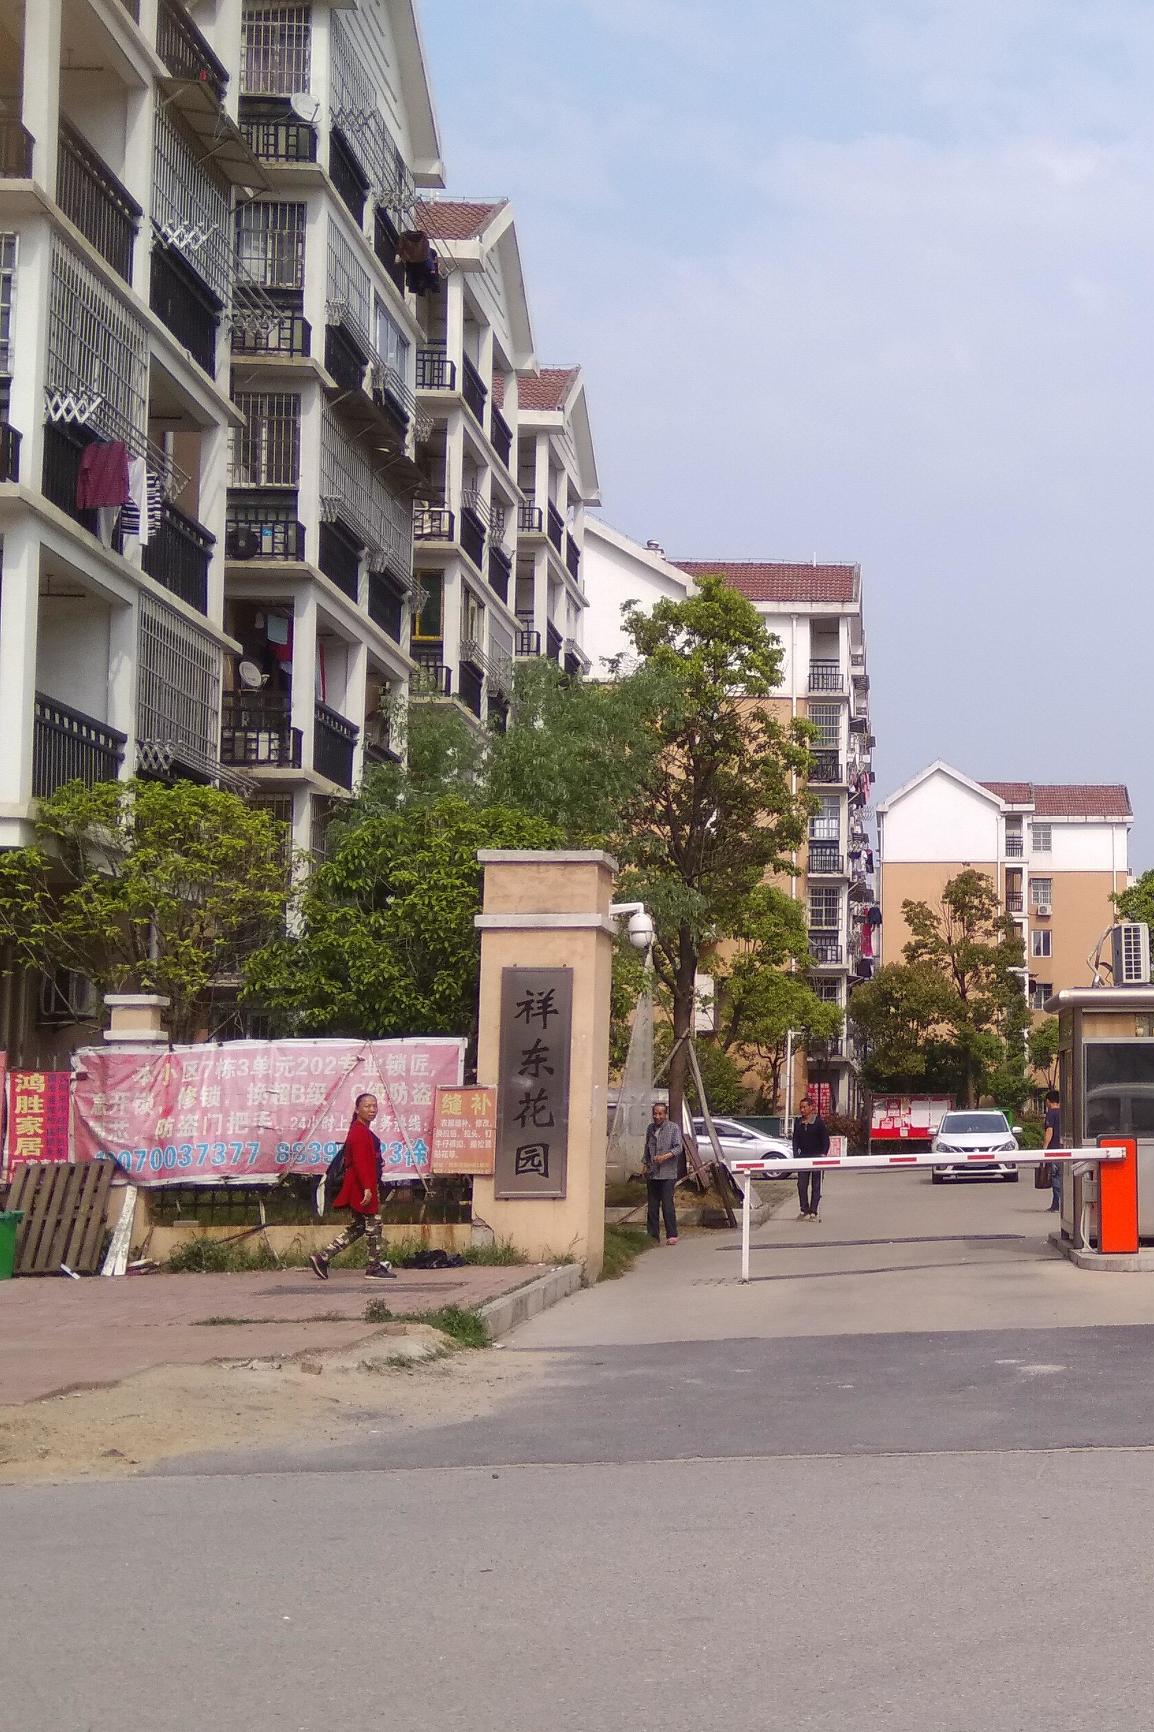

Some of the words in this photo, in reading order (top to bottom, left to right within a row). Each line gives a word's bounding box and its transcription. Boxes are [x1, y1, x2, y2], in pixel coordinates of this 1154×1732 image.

[14, 1072, 46, 1157] 鸿胜家居
[513, 988, 560, 1179] 祥东花园
